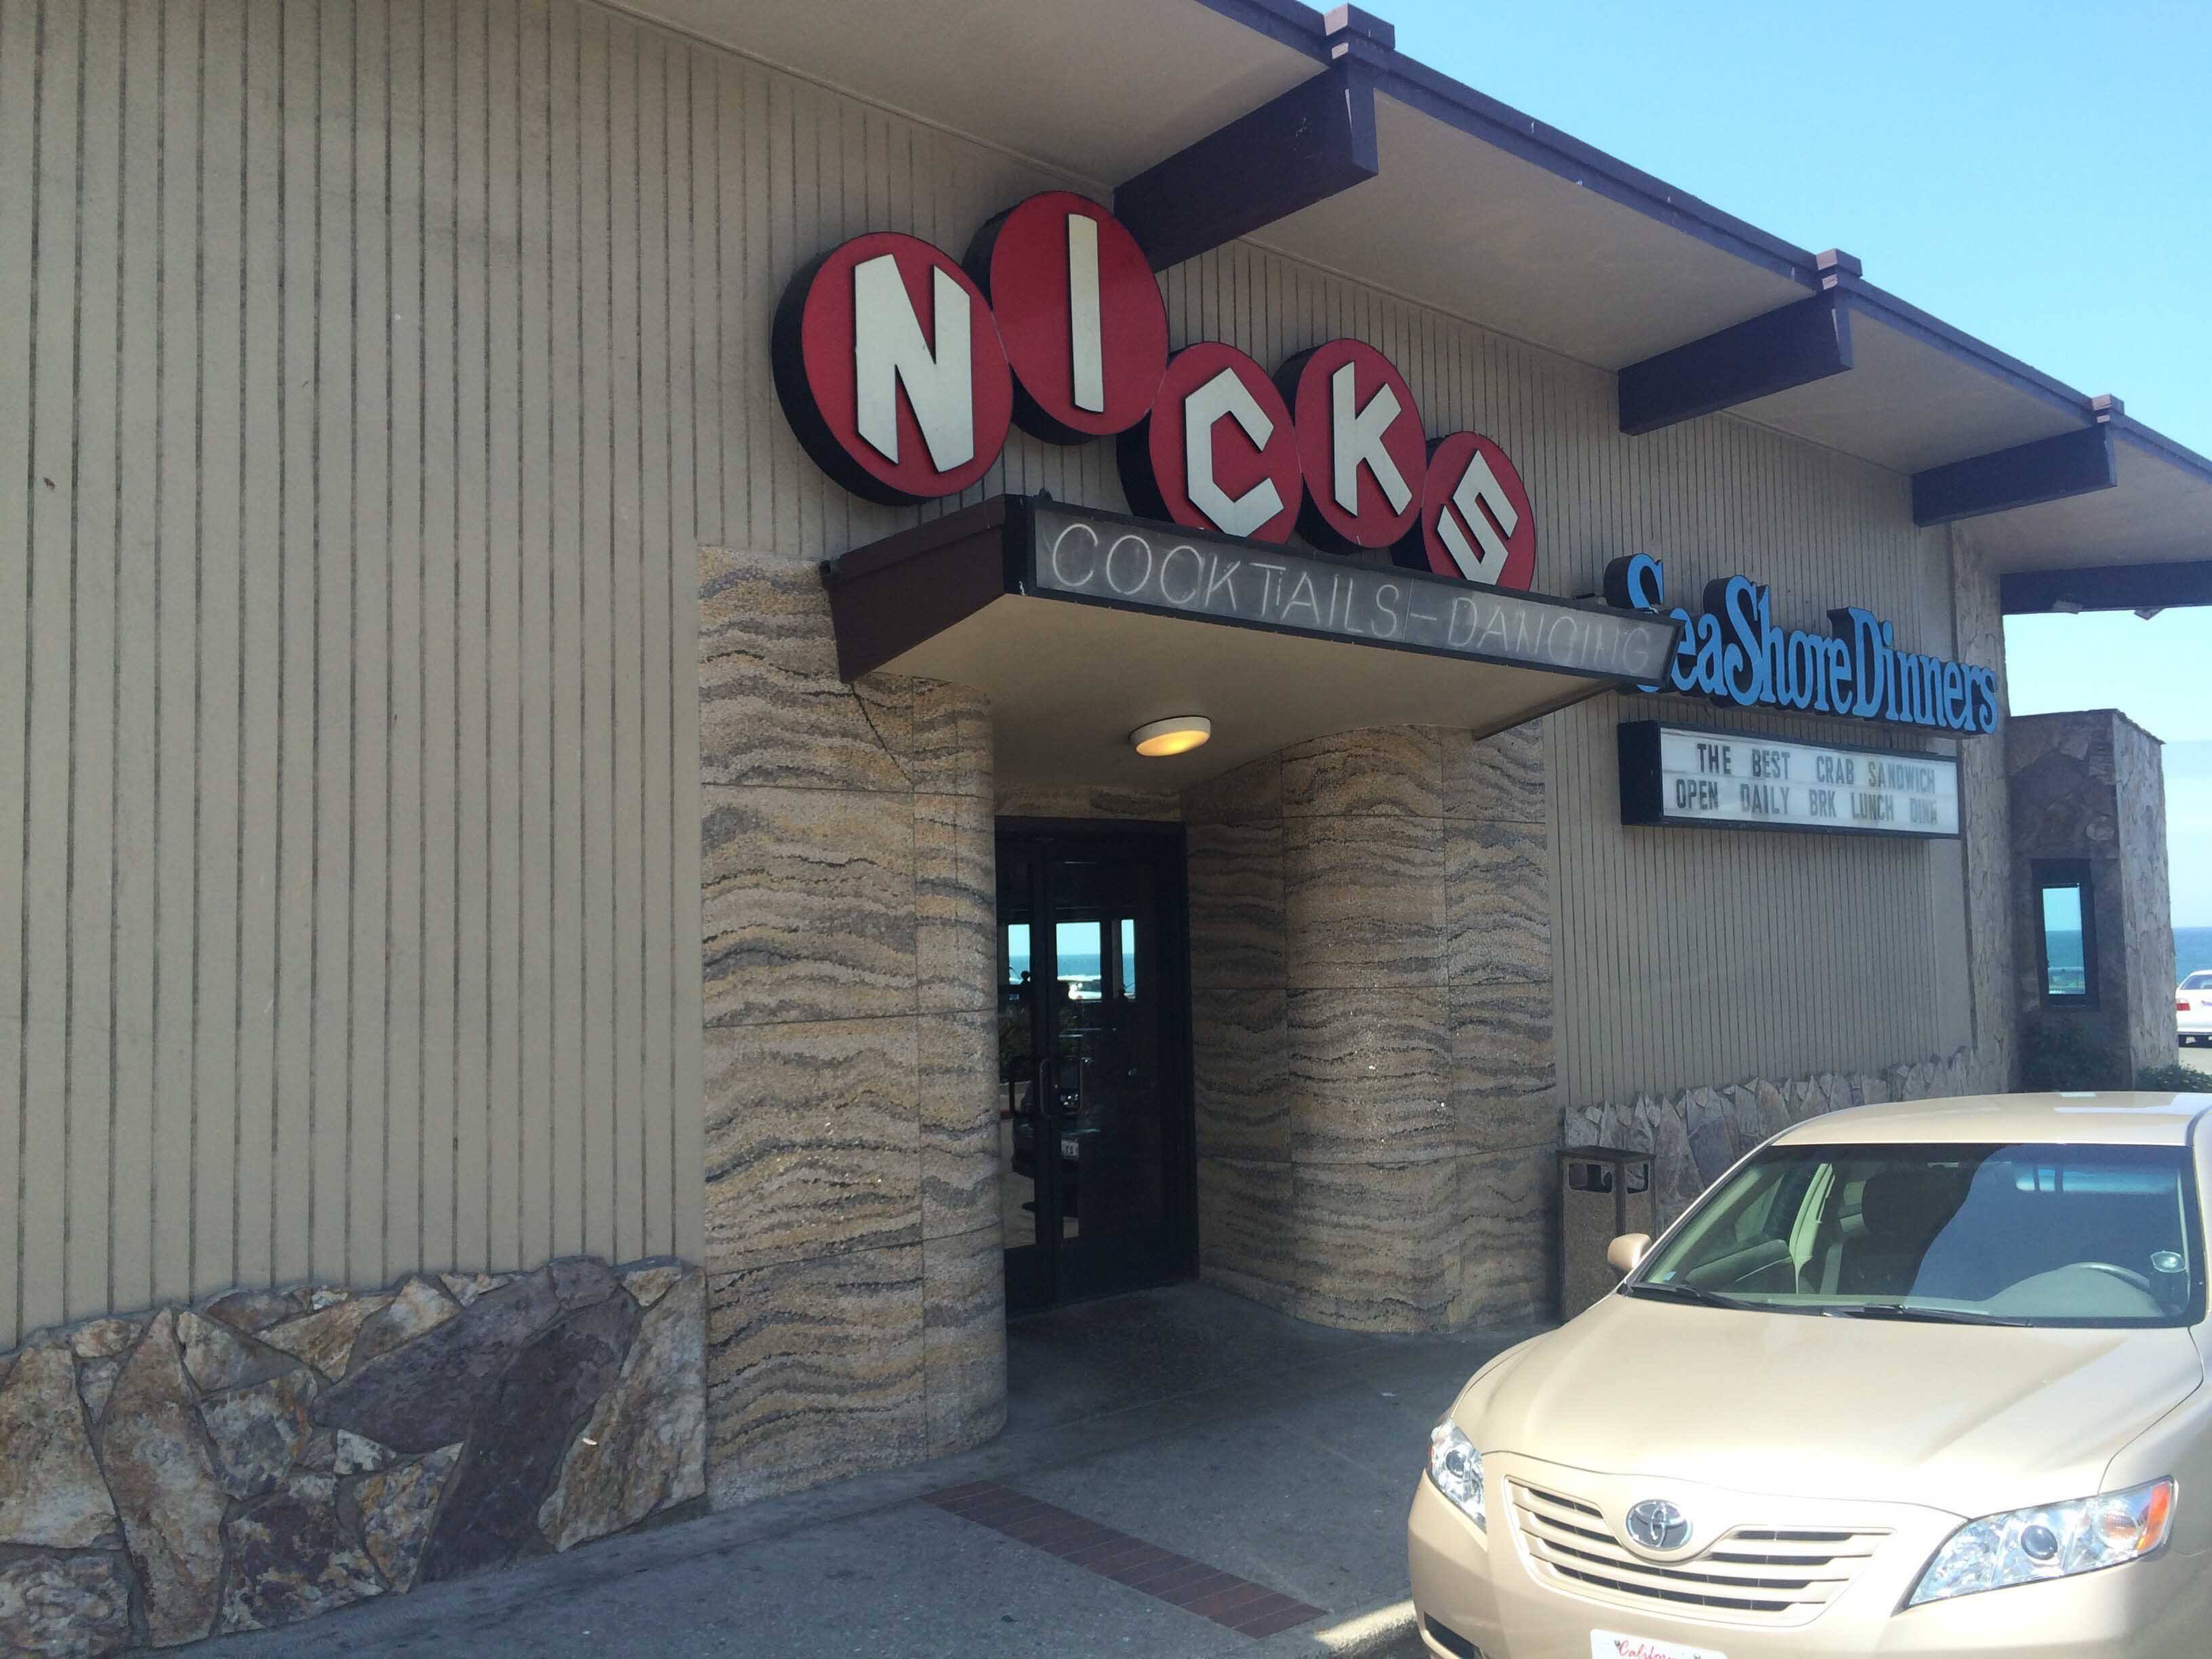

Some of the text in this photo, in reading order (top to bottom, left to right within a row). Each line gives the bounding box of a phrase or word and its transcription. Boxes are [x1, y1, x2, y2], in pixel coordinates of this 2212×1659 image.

[854, 213, 1519, 587] NICKS
[1697, 743, 1936, 795] THE BEST CRAB SANDWICH
[1675, 779, 1719, 811] OPEN
[1740, 783, 1790, 815] DAILY
[1809, 789, 1837, 818] BRK
[1850, 792, 1895, 822] LUNCH
